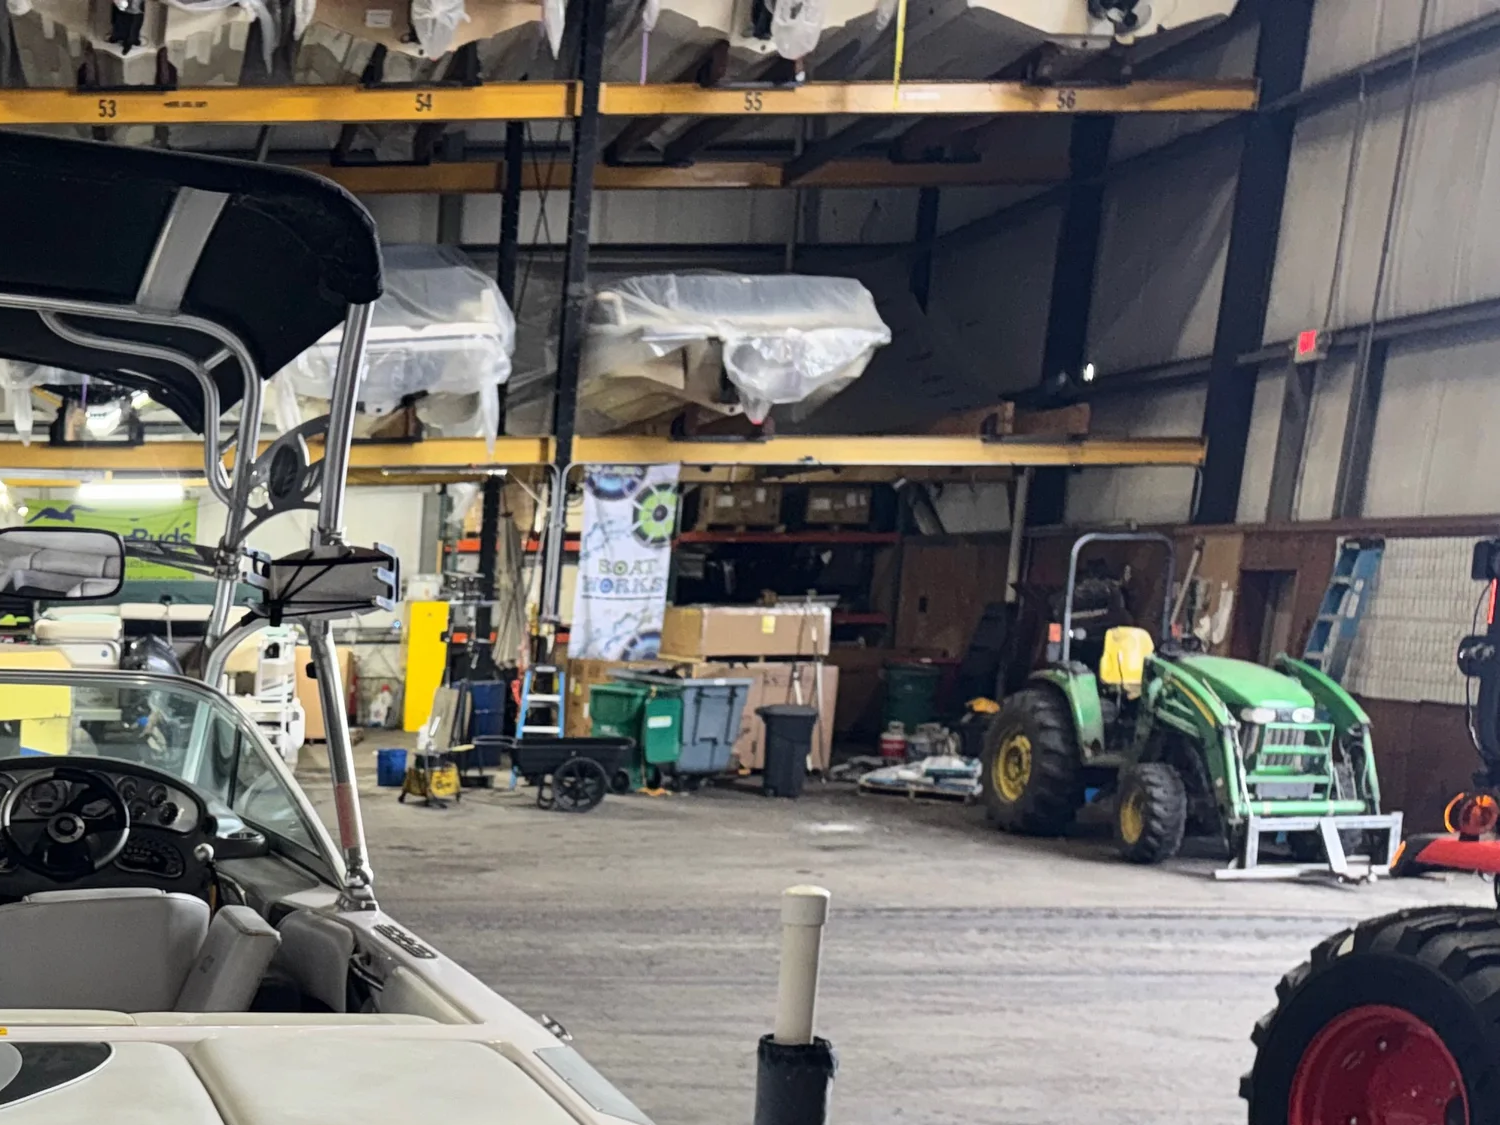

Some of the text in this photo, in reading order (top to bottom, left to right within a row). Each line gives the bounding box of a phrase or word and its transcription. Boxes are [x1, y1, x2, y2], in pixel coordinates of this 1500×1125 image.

[415, 93, 433, 111] 54
[744, 92, 763, 111] 55
[1057, 90, 1076, 109] 56
[97, 100, 117, 118] 53
[598, 558, 659, 576] BOAT
